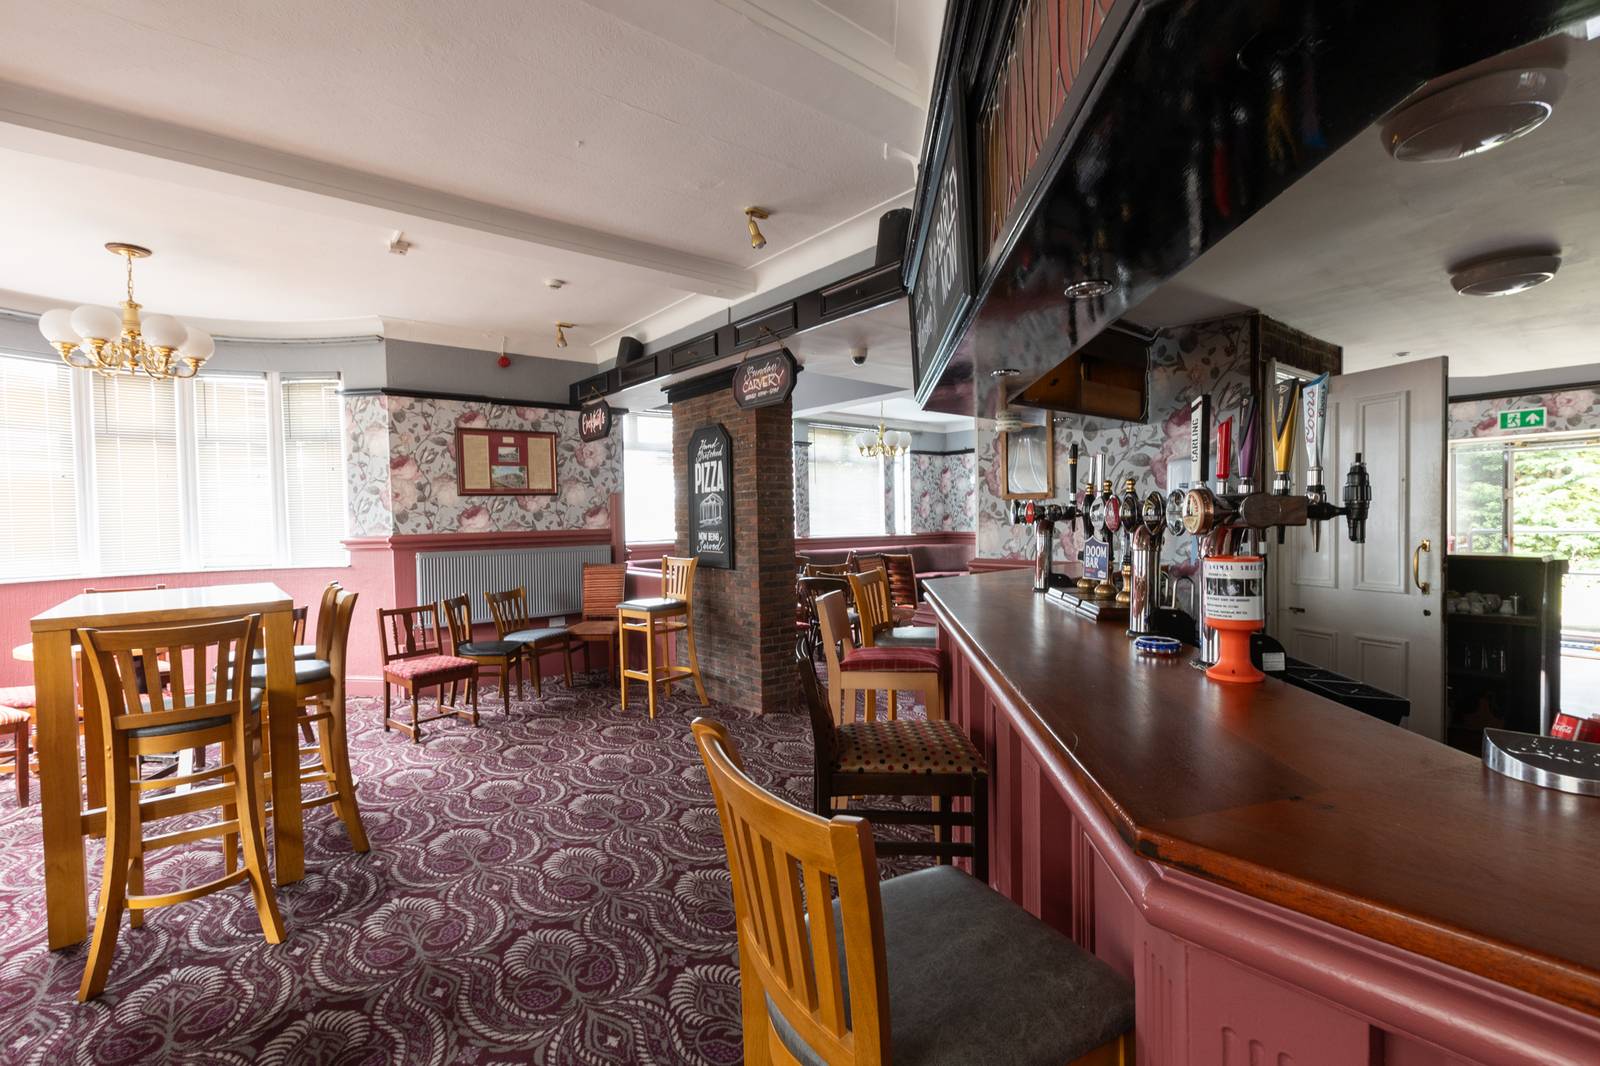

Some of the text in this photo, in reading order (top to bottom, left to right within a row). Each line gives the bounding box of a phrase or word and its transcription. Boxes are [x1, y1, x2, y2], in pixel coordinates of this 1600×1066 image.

[742, 368, 784, 393] CARVERY
[1304, 386, 1316, 443] Coors
[1191, 417, 1199, 463] CARLING
[694, 460, 725, 494] PIZZA
[1085, 545, 1107, 558] DOOM
[1085, 557, 1099, 569] BAR
